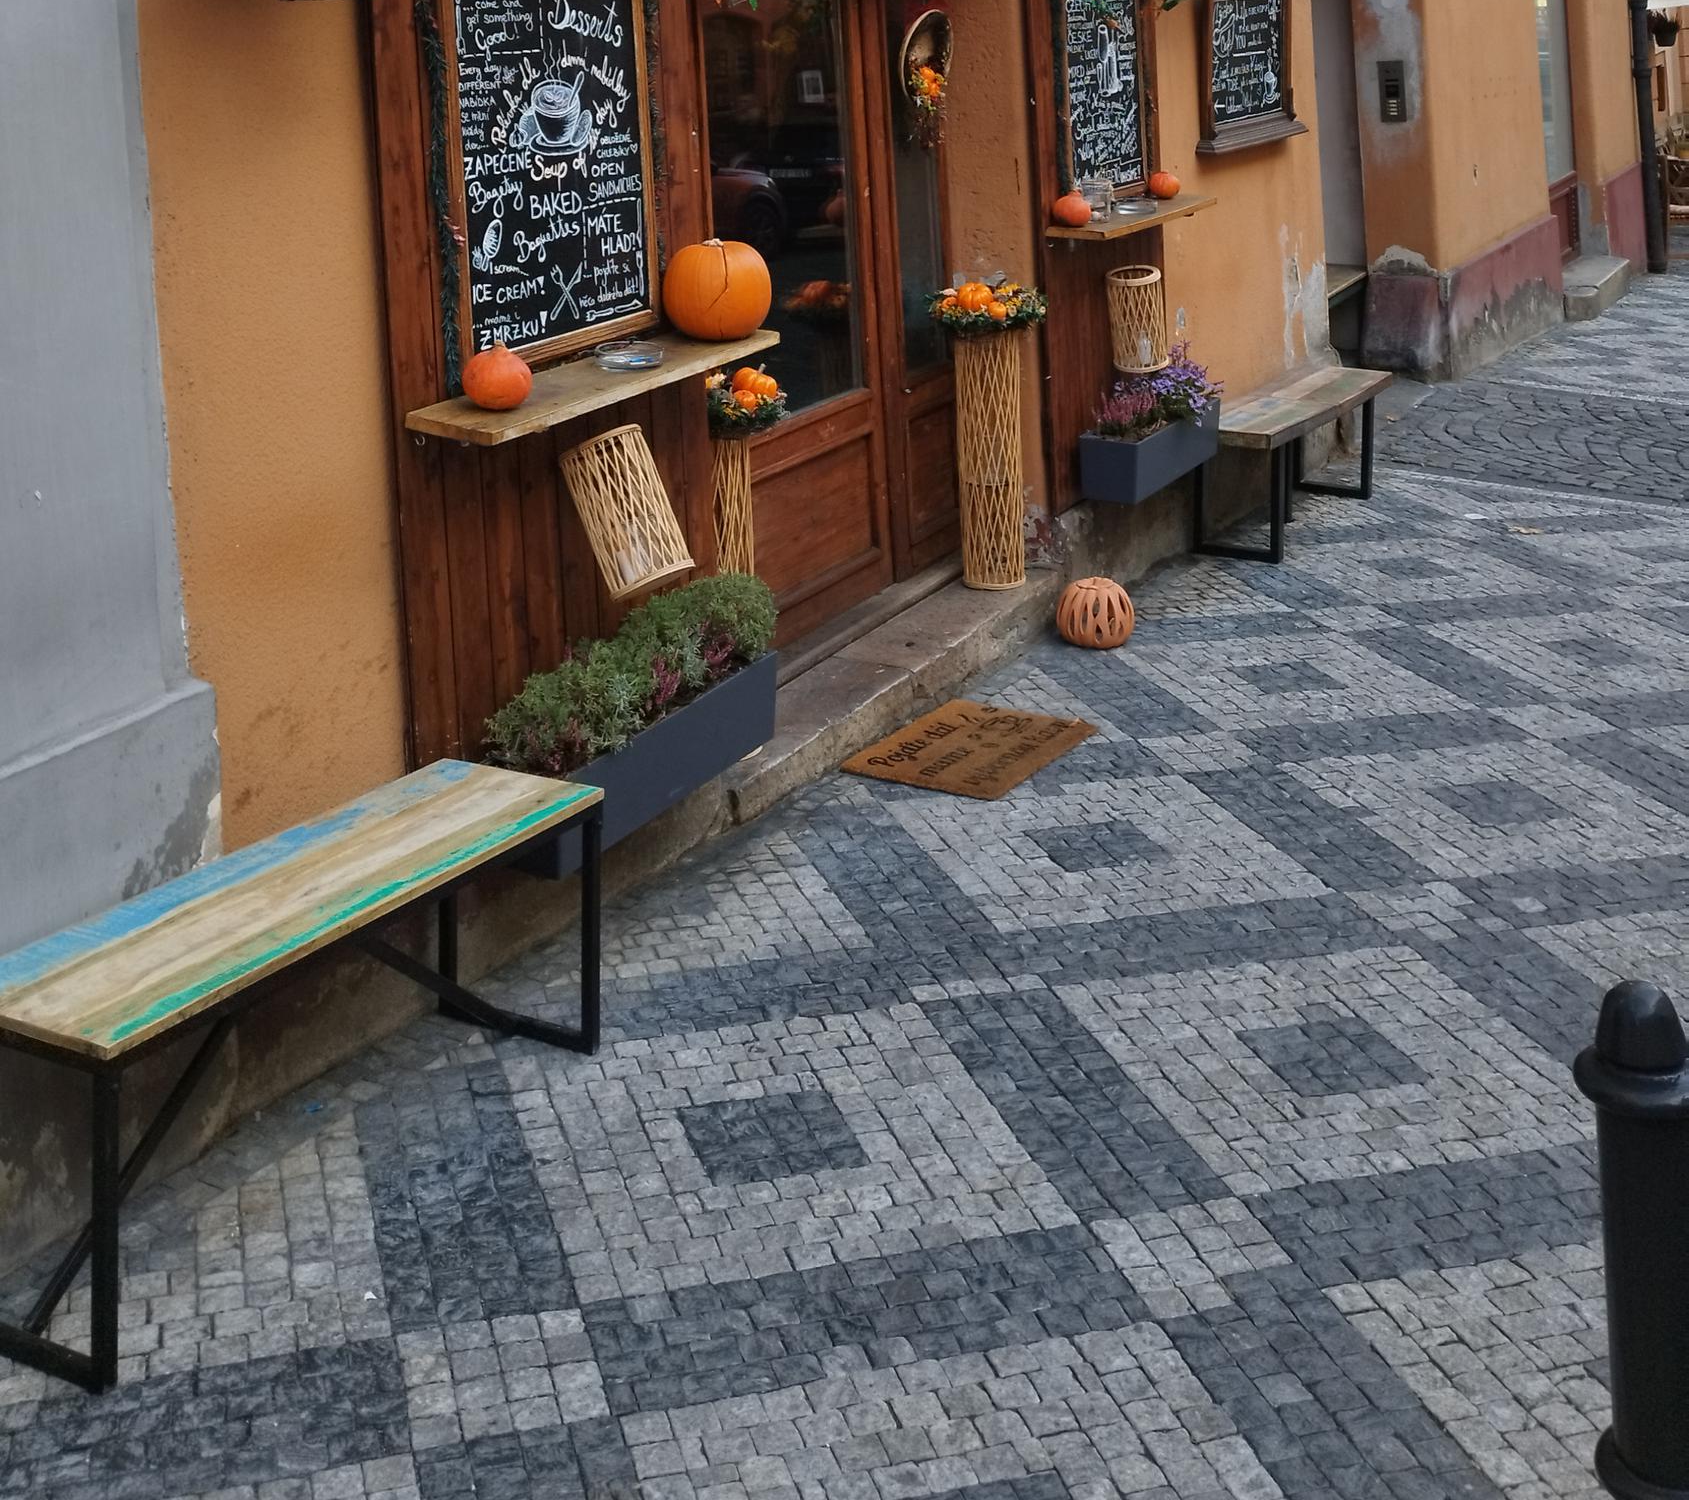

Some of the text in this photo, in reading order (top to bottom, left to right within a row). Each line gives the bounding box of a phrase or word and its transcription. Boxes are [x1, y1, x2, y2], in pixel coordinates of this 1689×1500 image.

[466, 8, 534, 32] get something
[458, 60, 502, 81] Every day
[458, 81, 502, 92] DIFFERENT
[531, 155, 568, 192] Soup
[595, 99, 618, 128] day
[463, 146, 533, 181] ZAPEČENÉ
[591, 160, 625, 177] OPEN
[468, 175, 524, 219] Bagety
[530, 190, 582, 220] BAKED
[587, 207, 623, 238] MÁTE
[513, 215, 581, 263] Baguettes
[601, 232, 637, 257] HLAD?
[473, 276, 546, 305] ICE CREAM!
